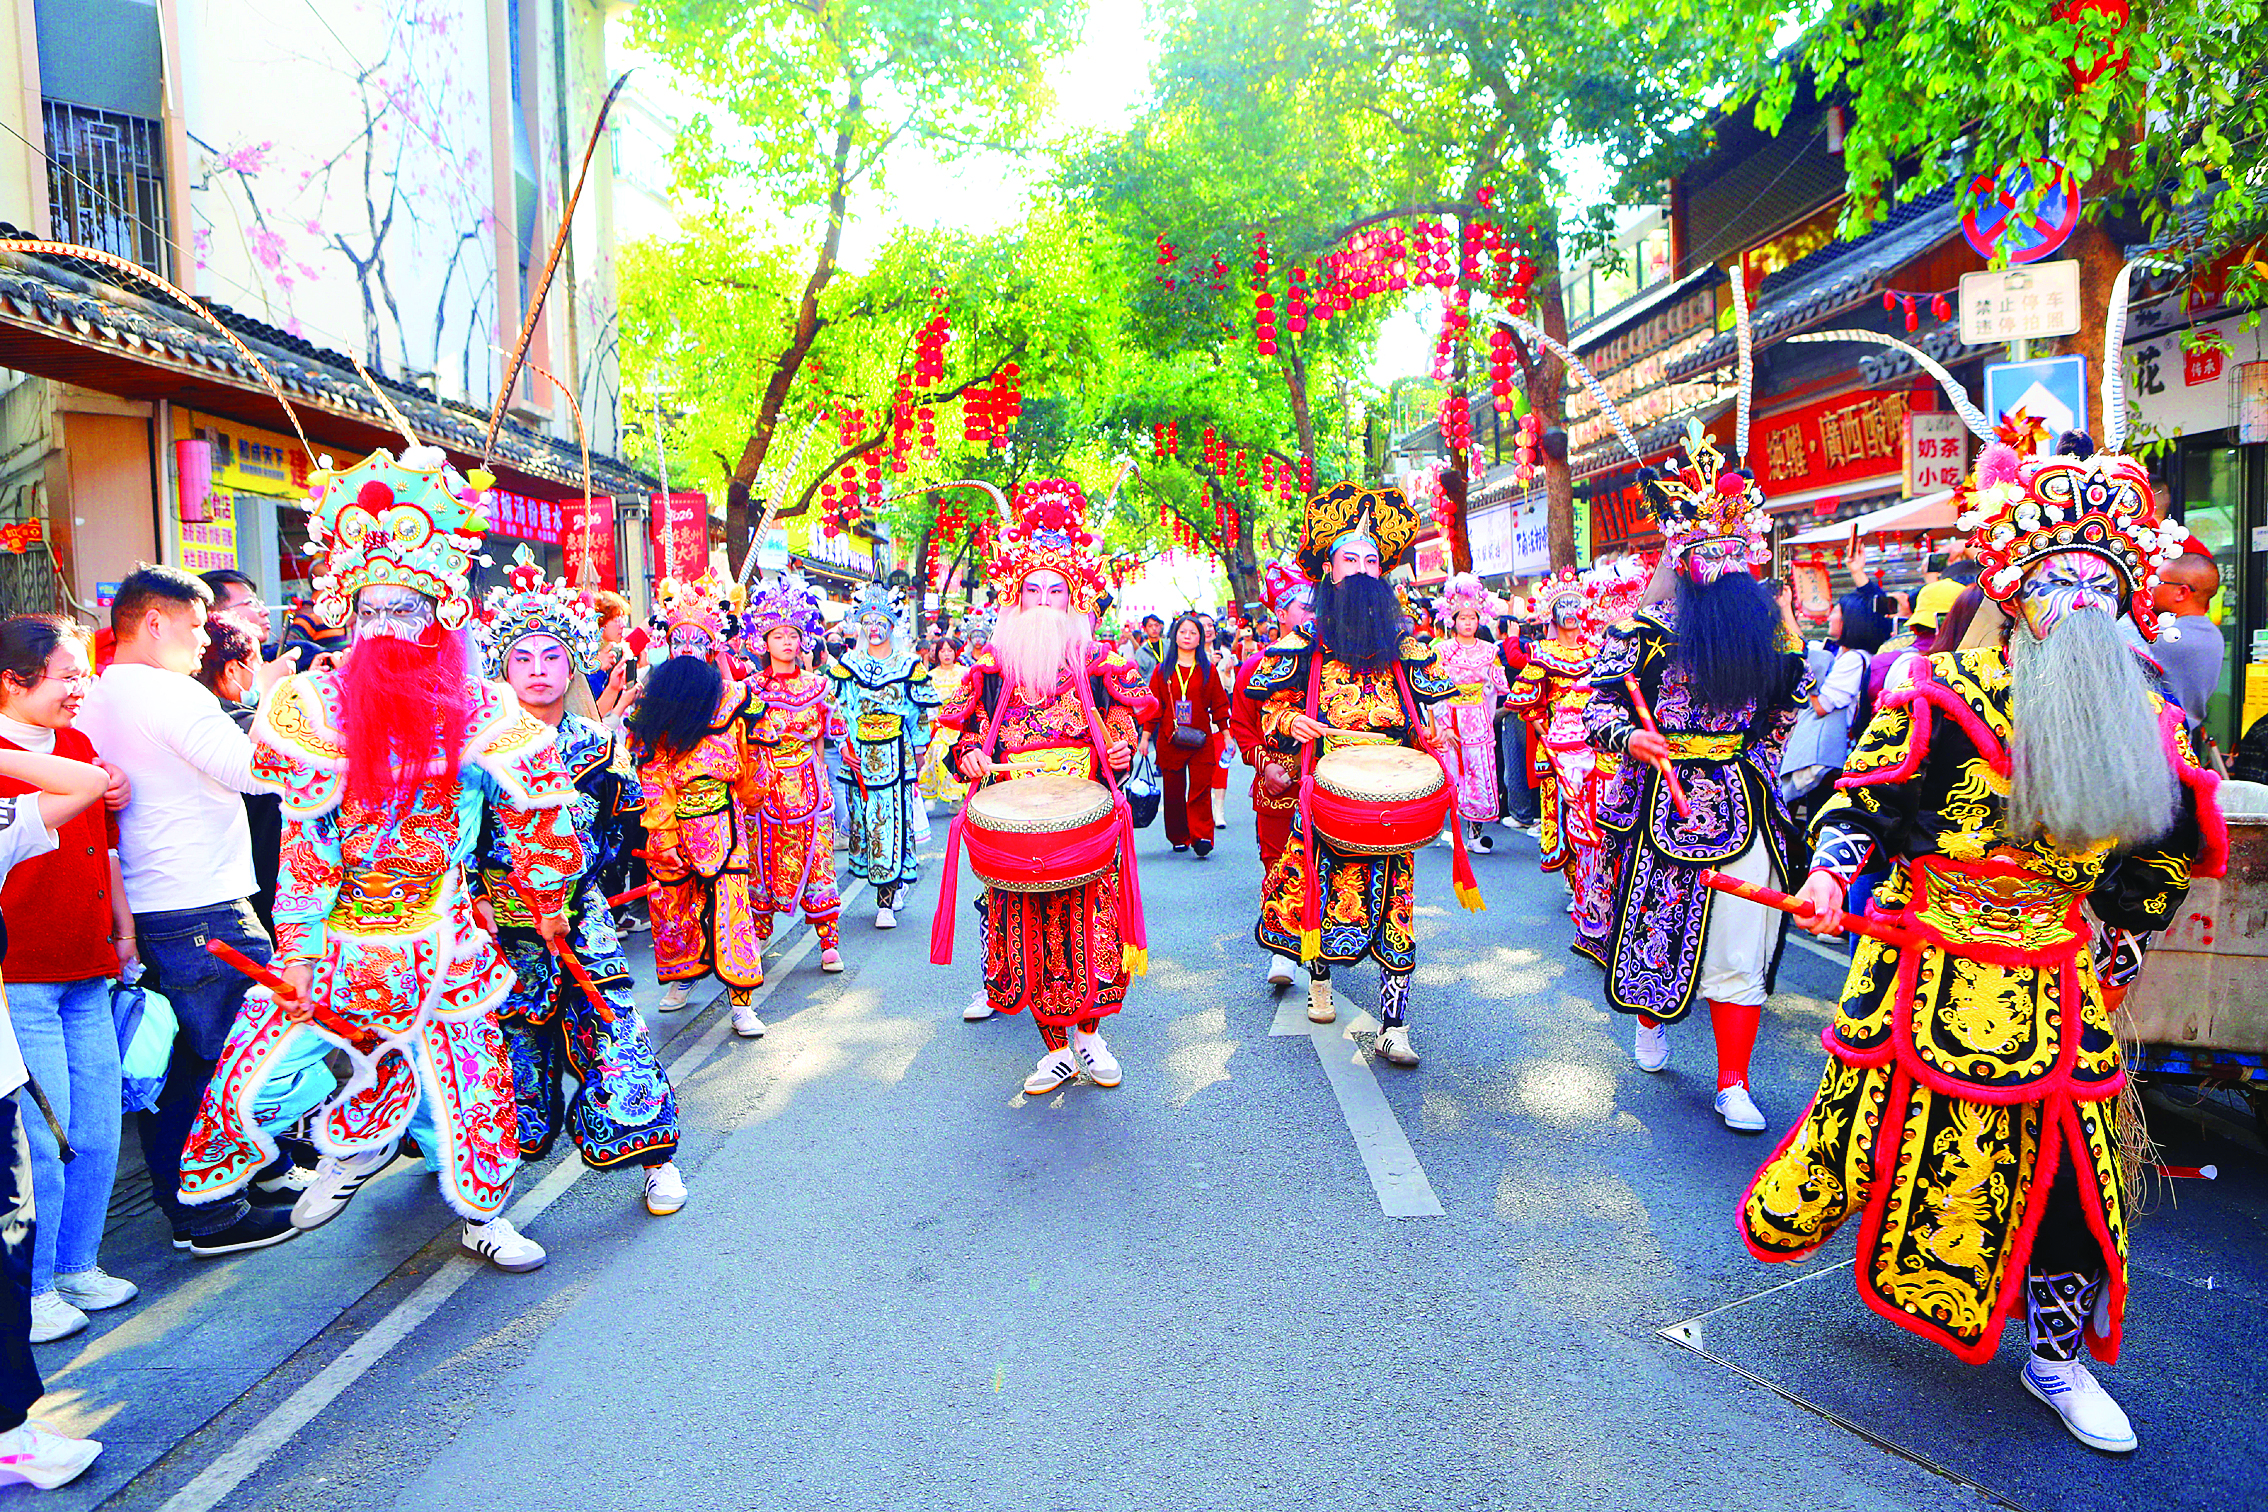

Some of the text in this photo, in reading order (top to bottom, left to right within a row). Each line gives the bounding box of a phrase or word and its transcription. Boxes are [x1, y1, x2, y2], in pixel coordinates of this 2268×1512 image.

[1975, 291, 2064, 316] 禁止停车
[1976, 311, 2064, 335] 违停拍照
[2137, 345, 2165, 397] 花
[1918, 437, 1960, 458] 奶茶
[1918, 466, 1960, 487] 小吃
